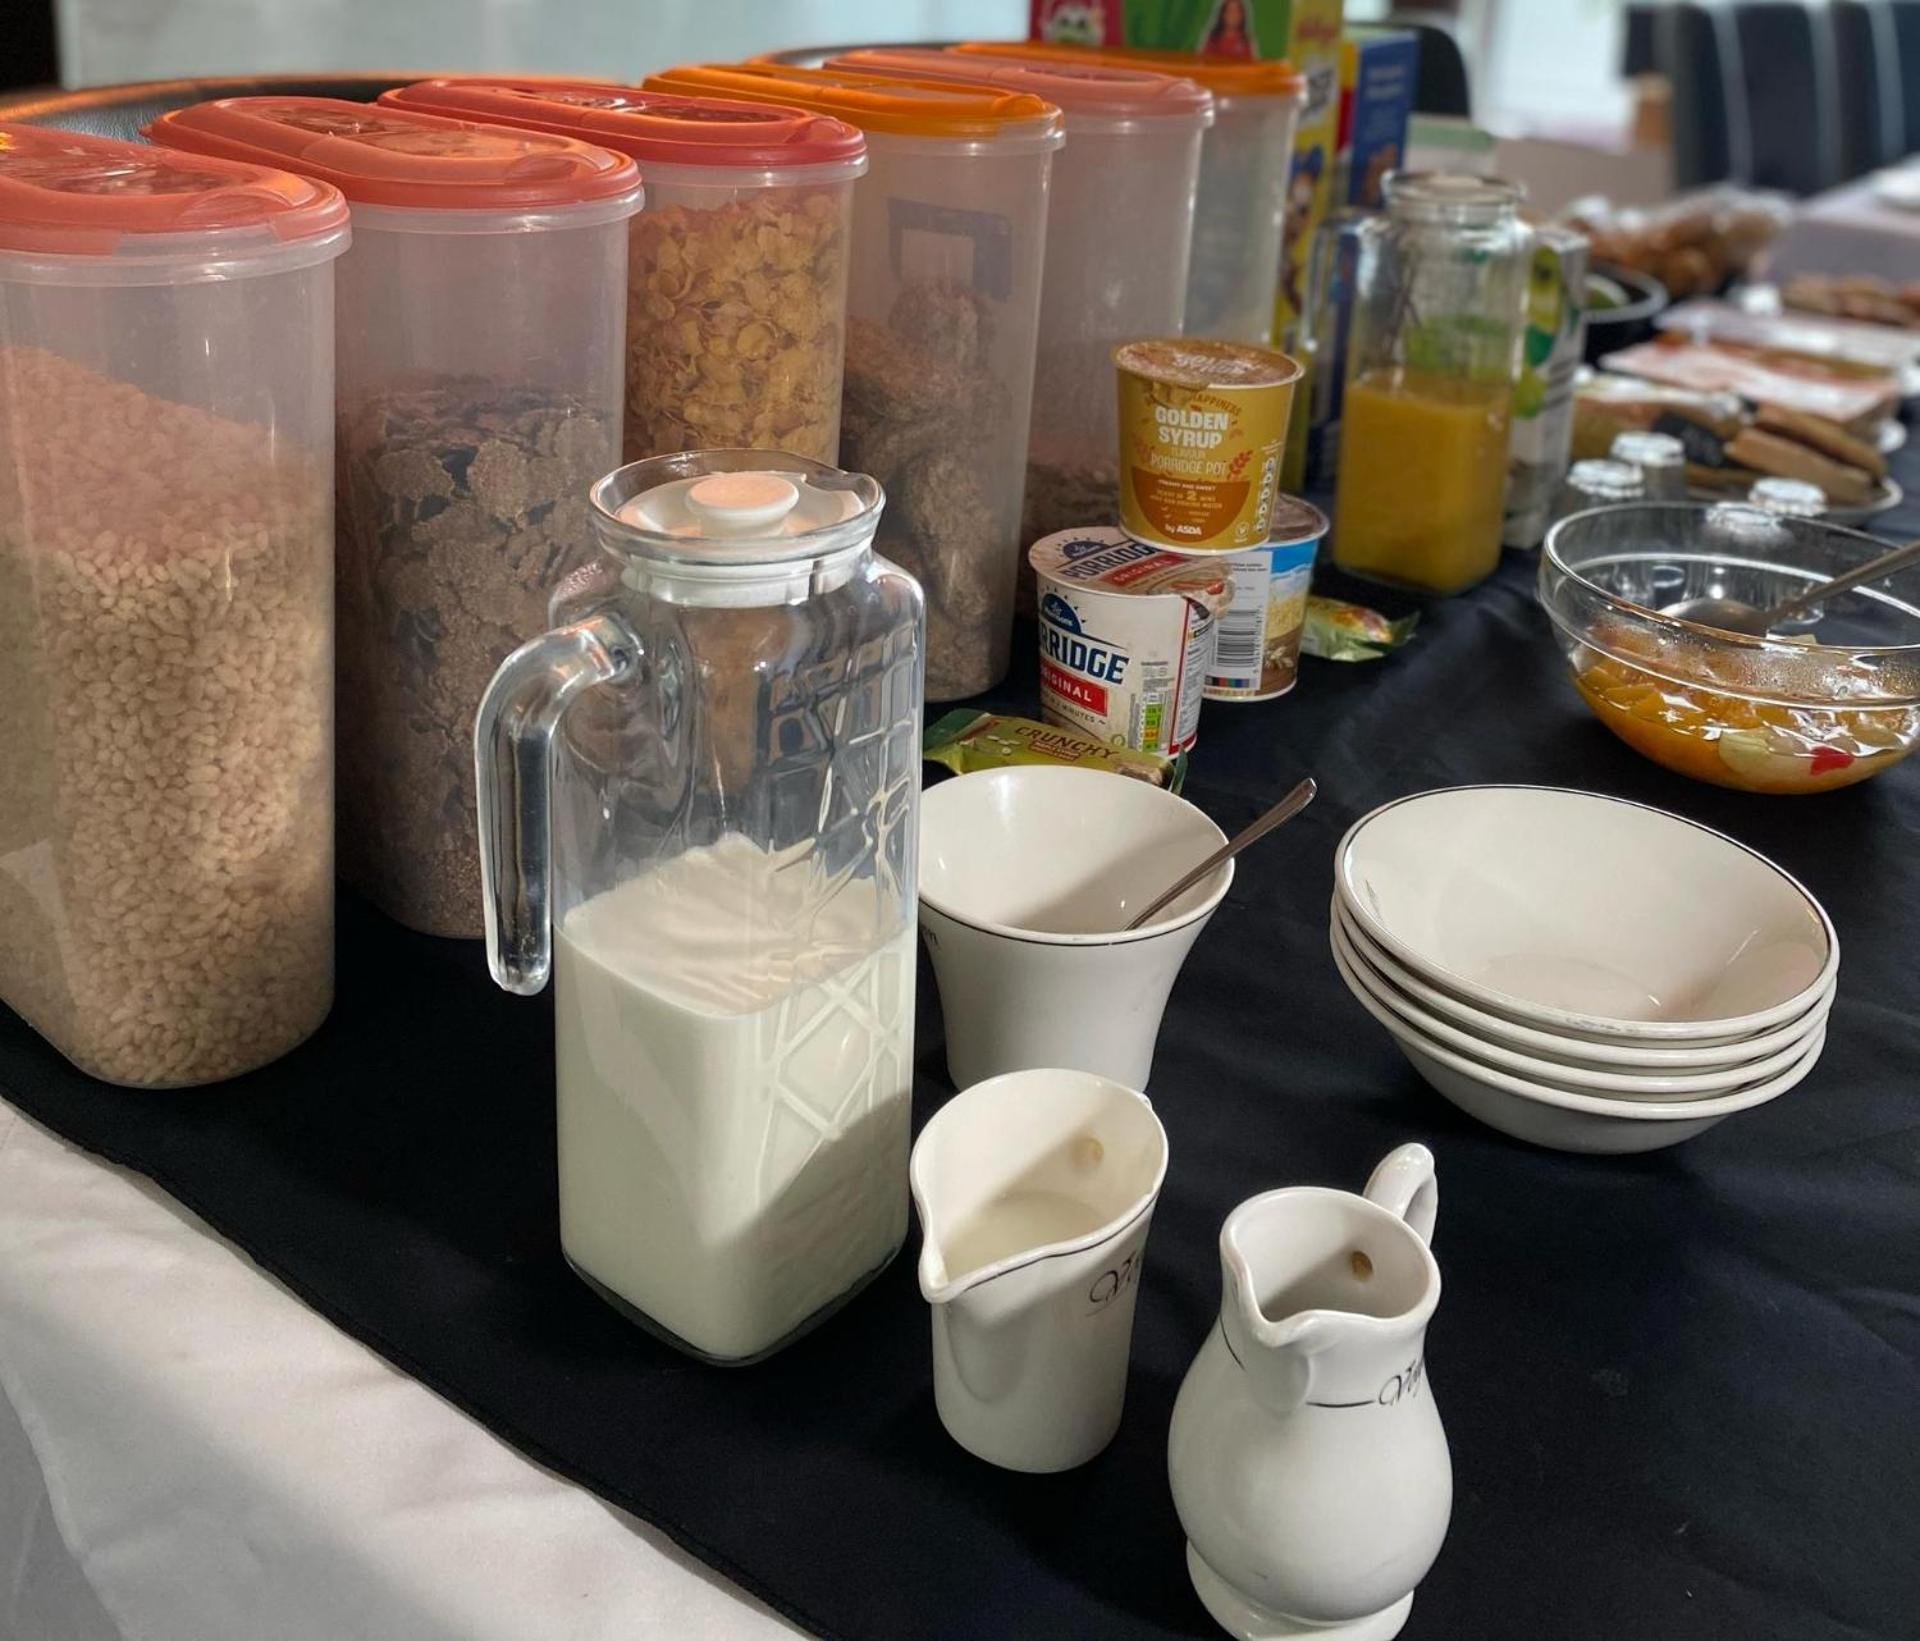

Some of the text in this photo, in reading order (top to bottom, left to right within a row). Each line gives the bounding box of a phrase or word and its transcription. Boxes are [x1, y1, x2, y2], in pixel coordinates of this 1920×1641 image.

[1155, 405, 1229, 431] GOLDEN
[1158, 426, 1223, 449] SYRUP
[1151, 452, 1226, 477] PORRIDGE POT
[1186, 490, 1198, 501] 2
[1165, 523, 1203, 536] by ASDA
[1059, 541, 1157, 580] PORRIDG
[1041, 620, 1130, 685] RRIDGE
[1015, 726, 1120, 759] CRUNCHY
